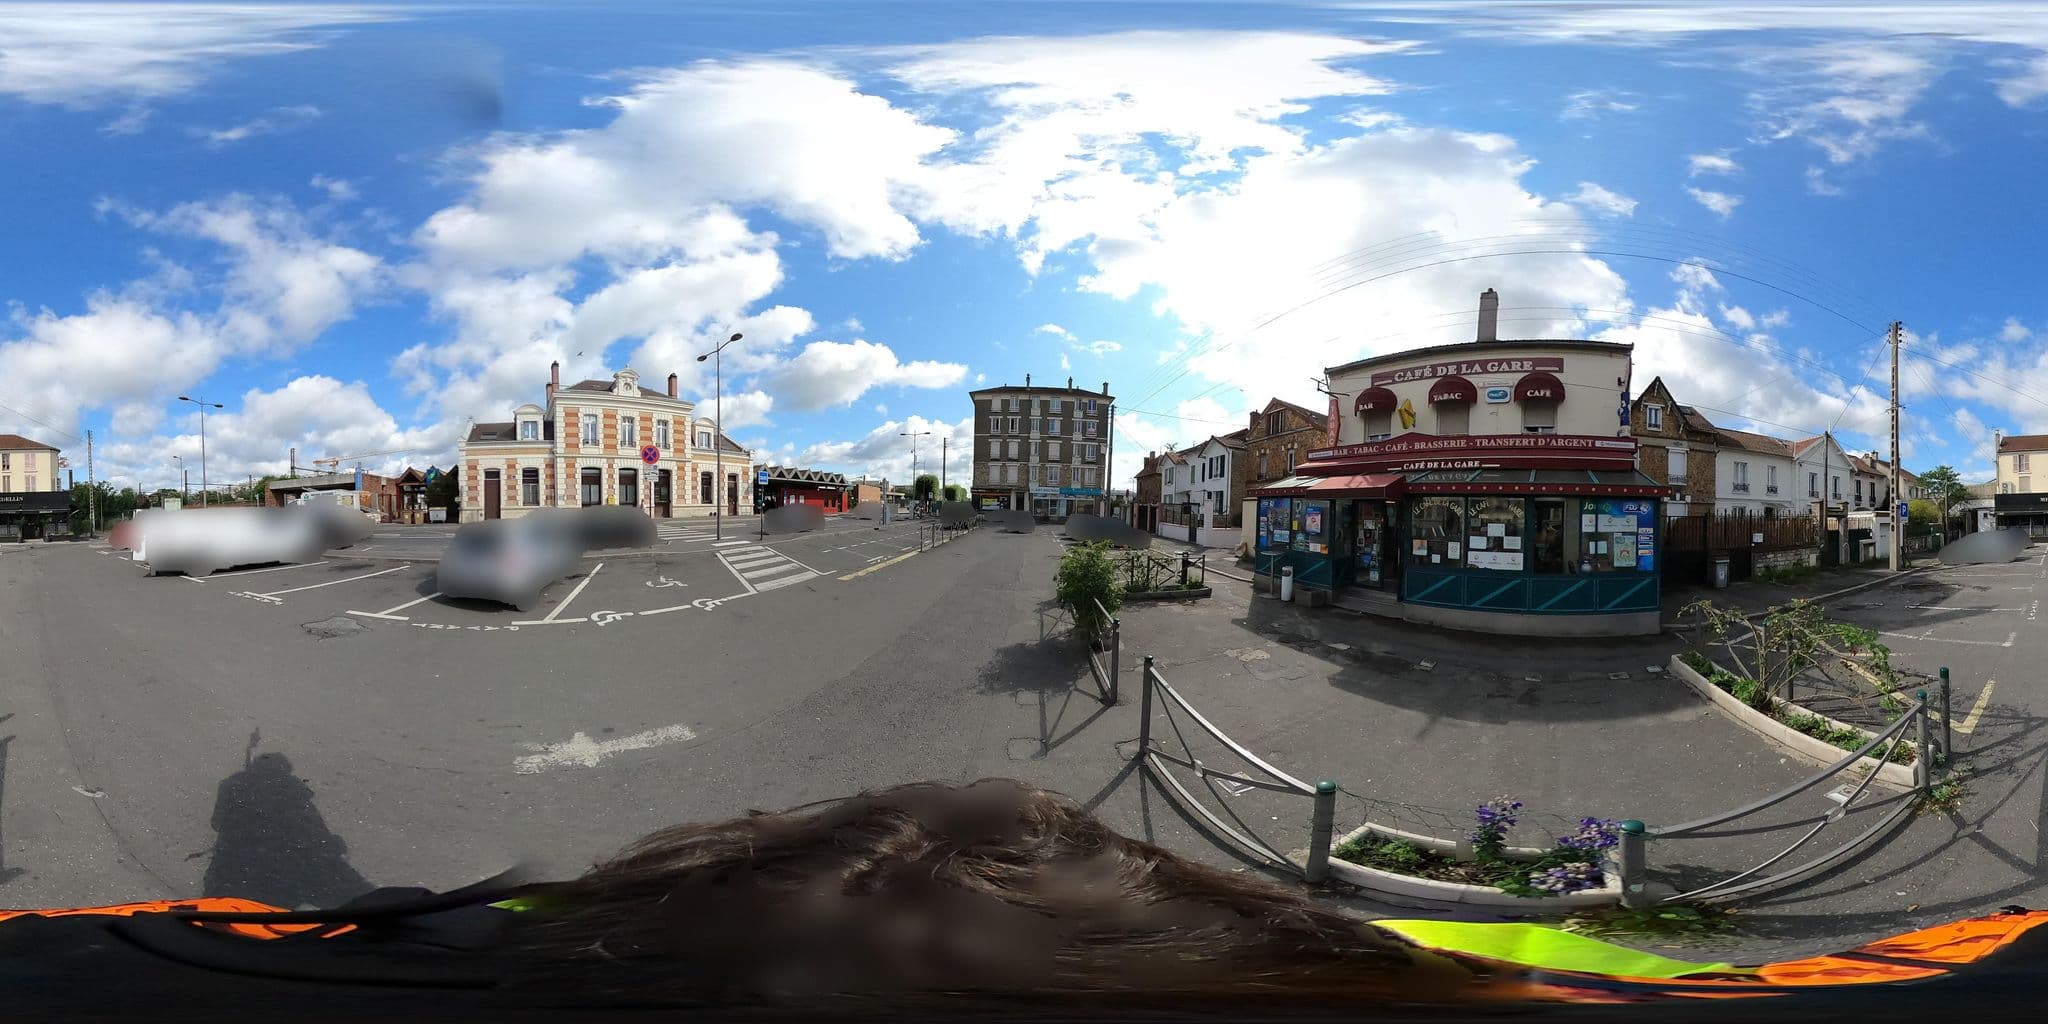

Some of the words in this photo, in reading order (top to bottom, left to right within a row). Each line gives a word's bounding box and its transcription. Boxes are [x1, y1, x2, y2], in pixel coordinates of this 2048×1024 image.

[1394, 365, 1433, 382] CAFÉ
[1436, 364, 1458, 377] DE
[1461, 363, 1483, 374] LA
[1486, 360, 1533, 372] GARE
[1433, 392, 1462, 402] TABAC
[1359, 403, 1374, 411] BAR
[1333, 448, 1348, 456] BAR
[1353, 445, 1380, 455] TABAC
[1386, 441, 1408, 452] CAFÉ
[1414, 439, 1467, 449] BRASSERIE
[1475, 438, 1535, 447] TRANSFERT
[1537, 438, 1594, 447] D'ARGENT
[1403, 461, 1425, 470] CAFÉ
[1427, 461, 1439, 469] DE
[1454, 460, 1480, 468] GARE
